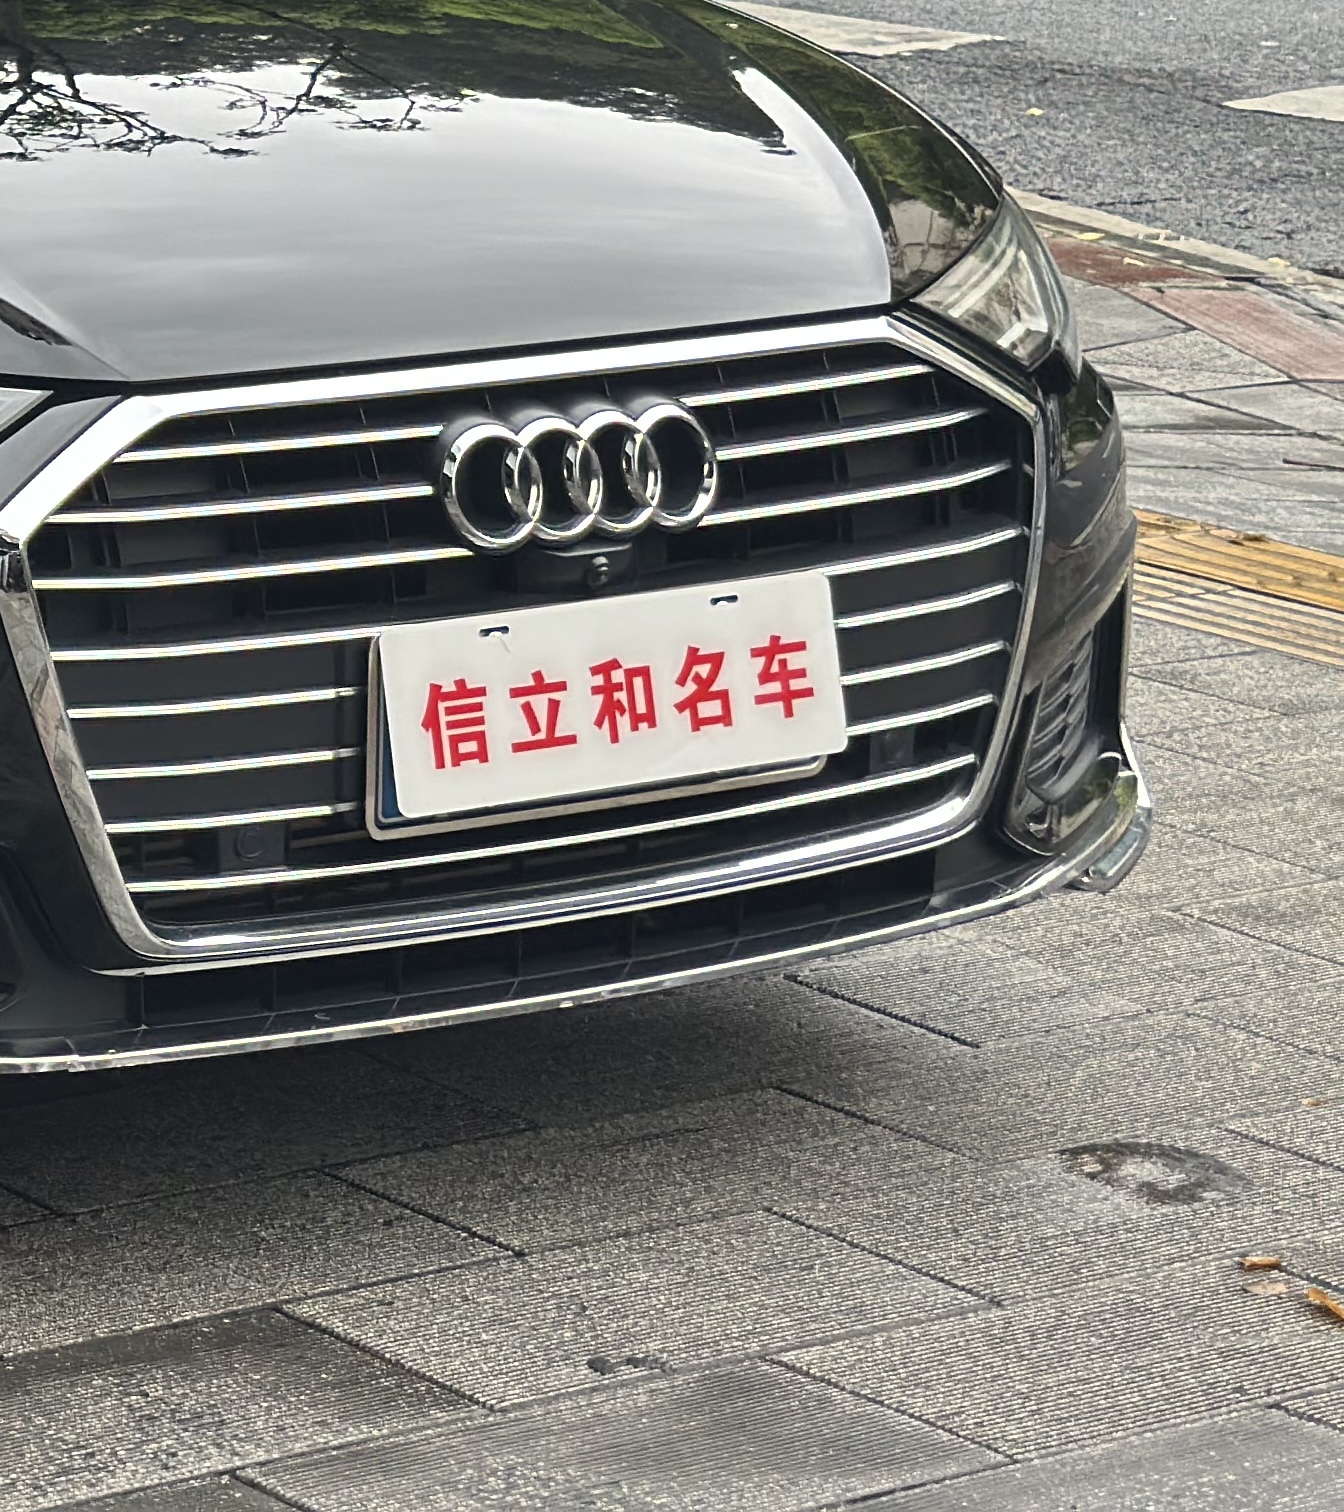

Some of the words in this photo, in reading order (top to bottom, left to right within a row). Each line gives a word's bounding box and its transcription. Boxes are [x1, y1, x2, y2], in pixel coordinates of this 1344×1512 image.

[420, 634, 815, 770] 信立和名车
